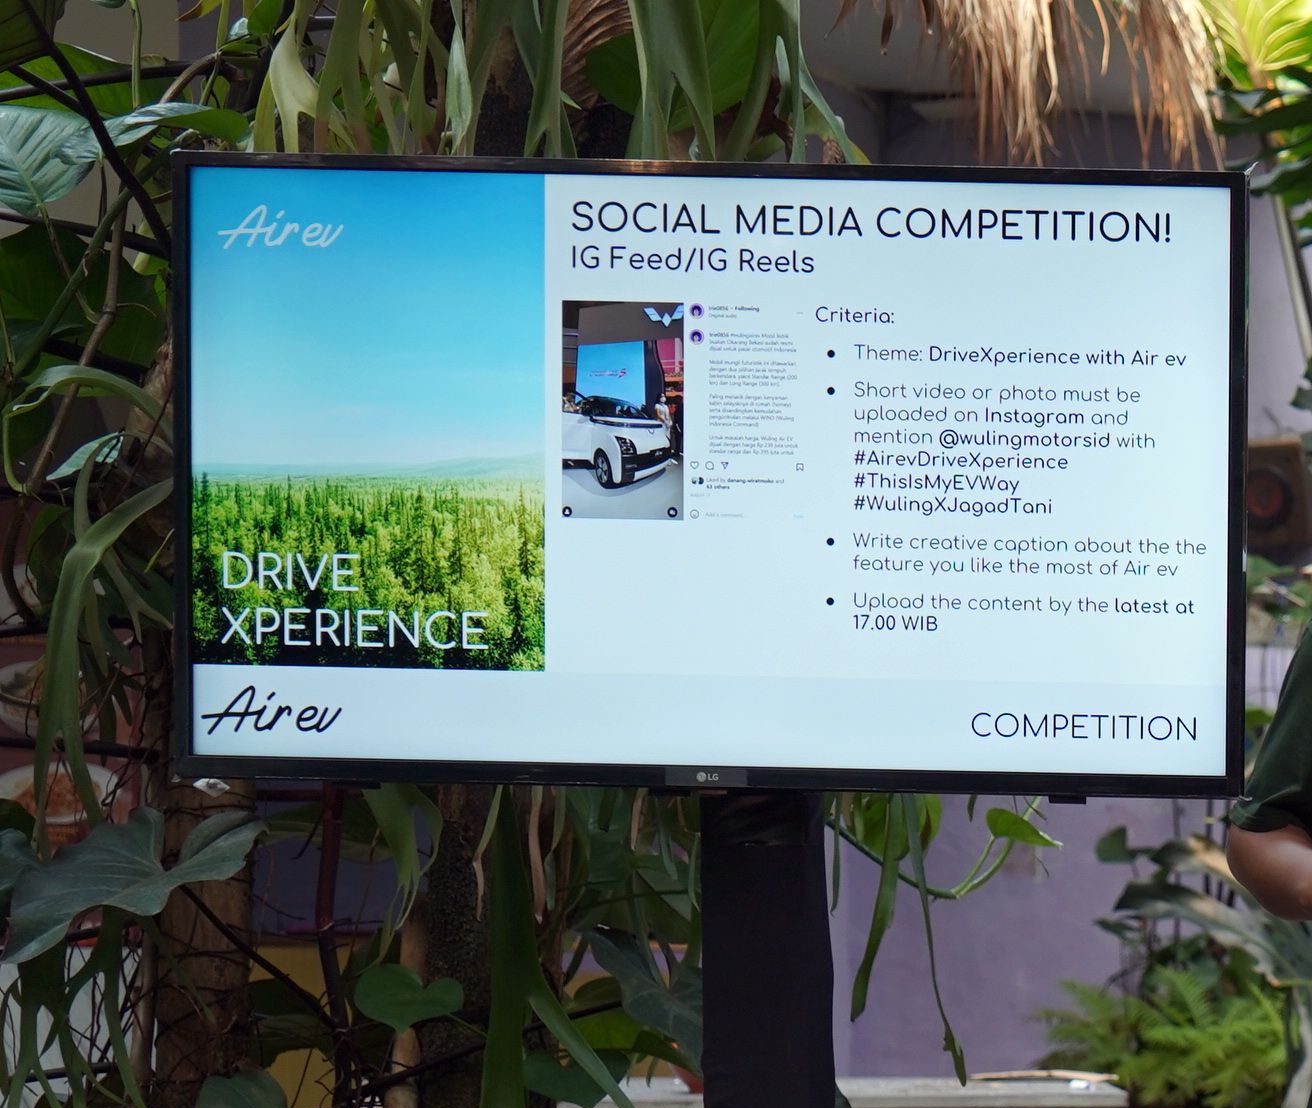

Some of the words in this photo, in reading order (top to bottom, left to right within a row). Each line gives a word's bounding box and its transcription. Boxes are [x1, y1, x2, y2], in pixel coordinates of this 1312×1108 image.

[572, 201, 720, 234] SOCIAL
[736, 205, 862, 237] MEDIA
[877, 207, 1170, 242] COMPETITION!
[573, 245, 599, 269] IG
[740, 249, 814, 273] Reels
[816, 306, 894, 323] Criteria:
[854, 344, 922, 361] Theme:
[930, 346, 1080, 367] DriveXperience
[1086, 350, 1124, 365] with
[1131, 350, 1158, 365] Air
[1165, 355, 1186, 366] ev
[855, 381, 906, 398] Short
[913, 384, 965, 399] video
[972, 388, 992, 399] or
[1000, 385, 1056, 404] photo
[1064, 388, 1109, 402] must
[1117, 387, 1140, 402] be
[855, 405, 947, 424] uploaded
[954, 411, 977, 422] on
[986, 408, 1084, 427] Instagram
[1091, 410, 1128, 425] and
[855, 430, 932, 444] mention
[939, 429, 1110, 452] @wulingmotorsid
[1117, 433, 1155, 448] with
[854, 451, 1068, 472] #AirevDriveXperience
[855, 473, 1019, 495] #ThisIsMyEVWay
[854, 495, 1051, 517] #WulingXJagadTani
[853, 533, 903, 549] Write
[910, 535, 987, 550] creative
[994, 537, 1067, 555] caption
[1075, 537, 1132, 553] about
[1139, 538, 1169, 554] the
[1176, 539, 1206, 554] the
[222, 552, 360, 592] DRIVE
[853, 555, 923, 571] feature
[930, 561, 963, 575] you
[971, 557, 1002, 573] like
[1009, 558, 1039, 574] the
[1047, 561, 1092, 575] most
[1100, 560, 1118, 575] of
[1124, 561, 1150, 575] Air
[1157, 565, 1178, 576] ev
[854, 593, 923, 611] Upload
[931, 594, 961, 609] the
[968, 597, 1042, 611] content
[1050, 596, 1071, 616] by
[1078, 597, 1108, 612] the
[1115, 598, 1168, 613] latest
[1176, 600, 1194, 614] at
[221, 607, 490, 650] XPERIENCE
[853, 615, 895, 630] 17.00
[902, 616, 937, 631] WIB
[972, 713, 1196, 741] COMPETITION
